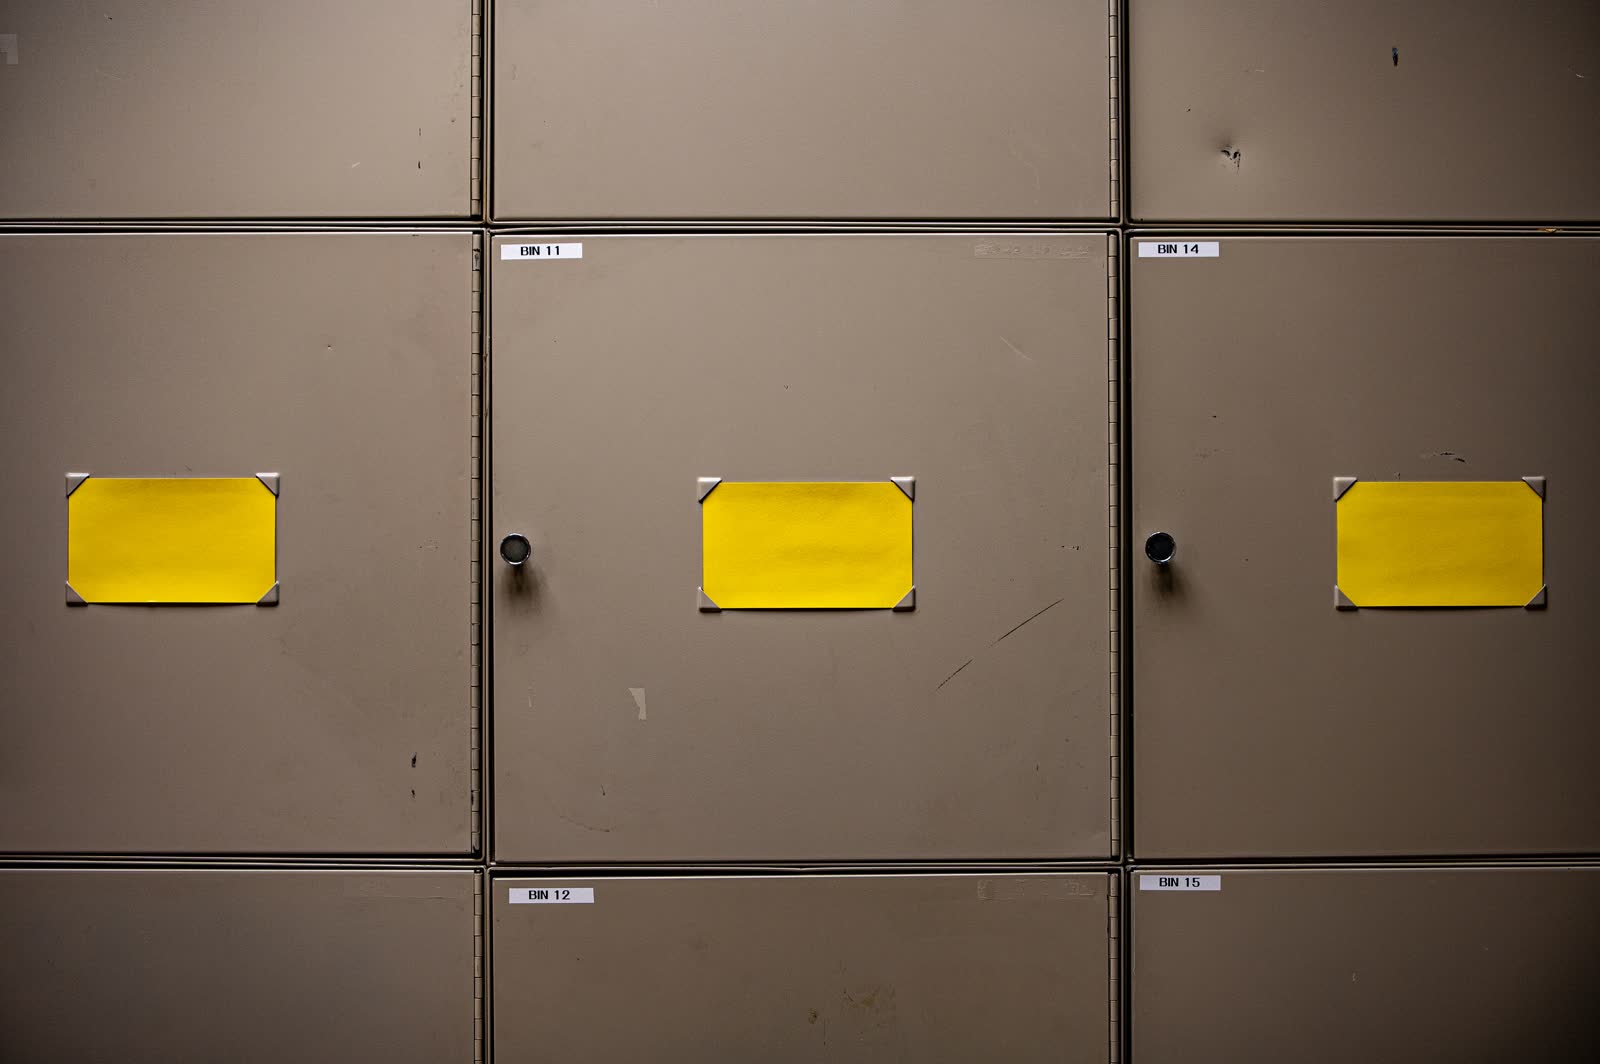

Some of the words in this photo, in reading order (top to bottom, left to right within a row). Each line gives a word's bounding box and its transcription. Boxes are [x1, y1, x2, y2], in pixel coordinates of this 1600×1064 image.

[520, 246, 541, 256] BIN
[546, 245, 560, 256] 11
[1157, 244, 1178, 254] BIN
[1183, 244, 1199, 254] 14
[1159, 877, 1179, 887] BIN
[1184, 877, 1200, 888] 15
[528, 890, 549, 900] BIN
[554, 889, 571, 900] 12
